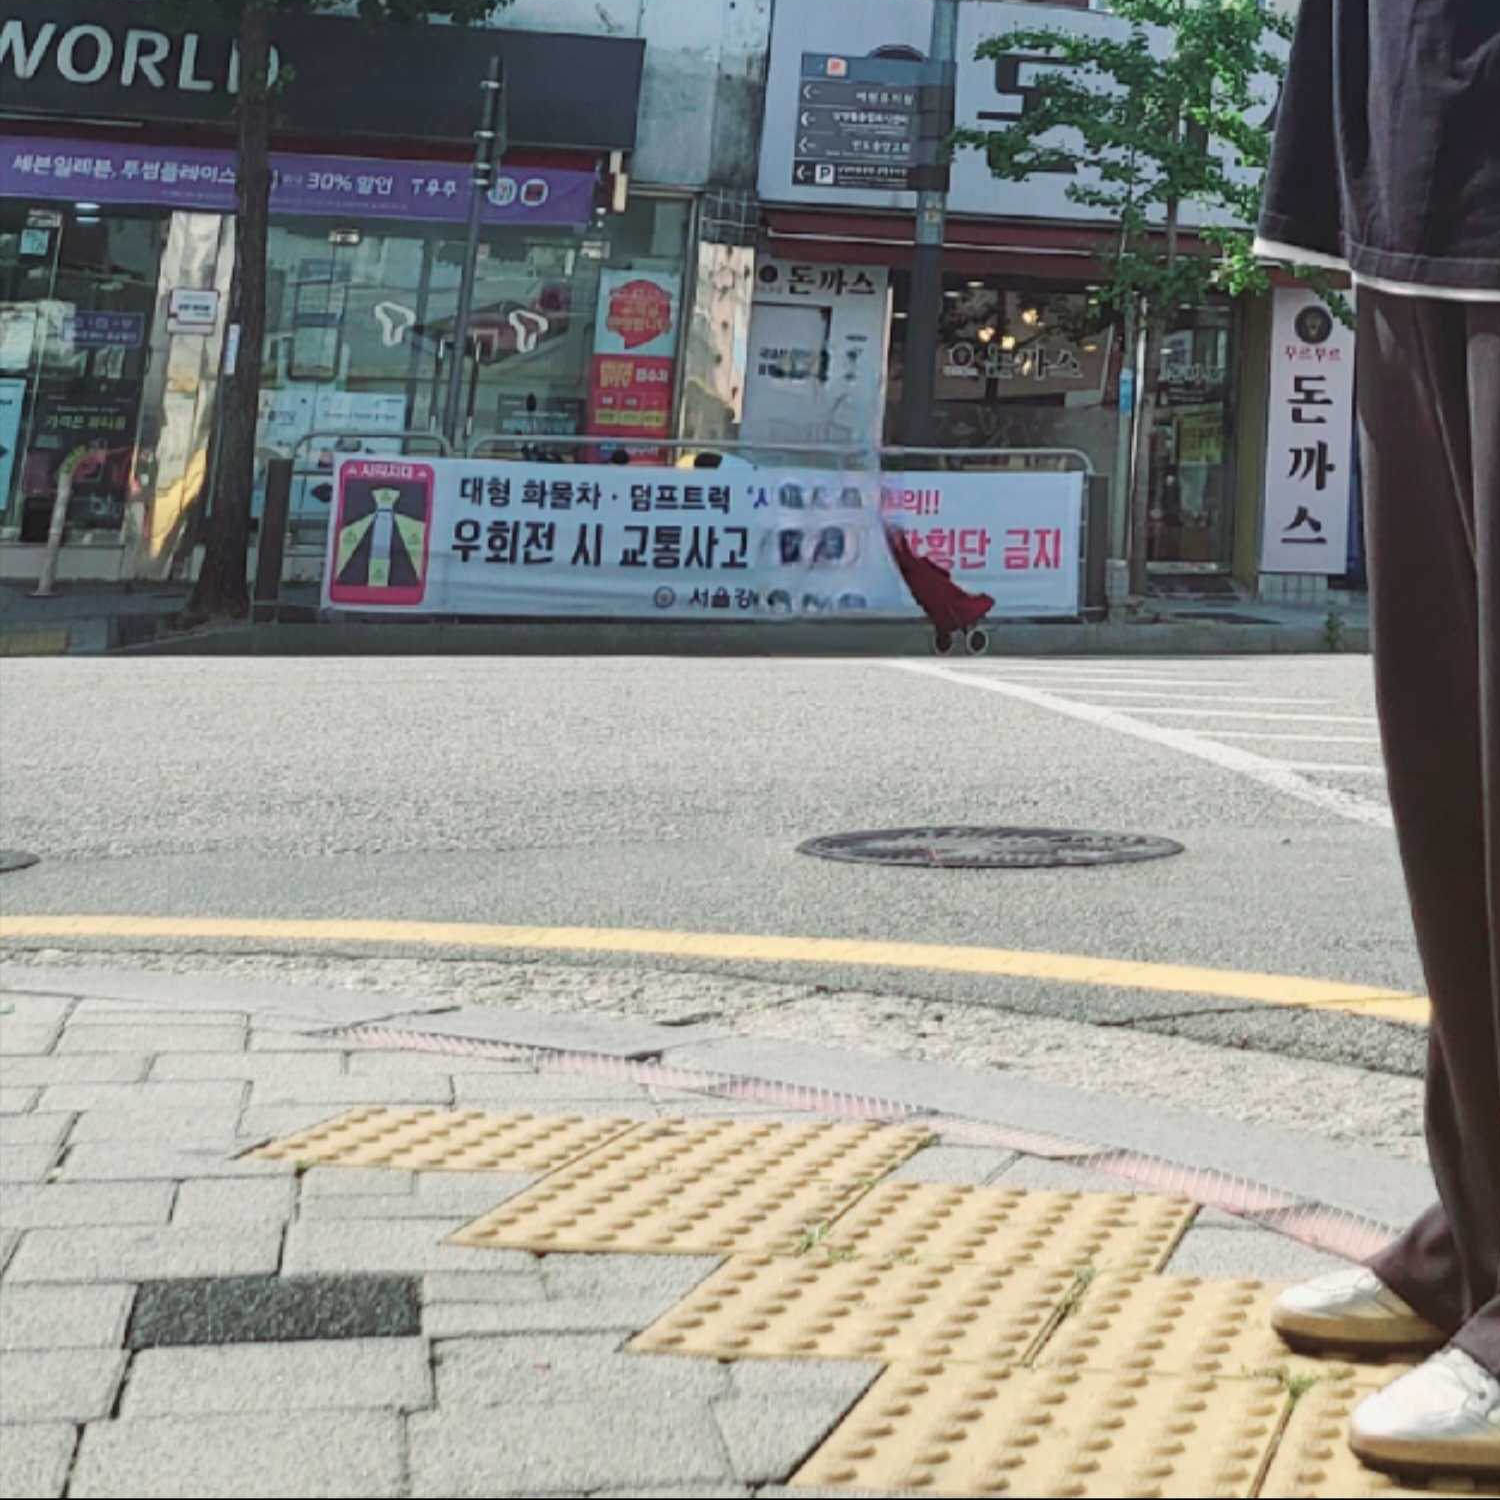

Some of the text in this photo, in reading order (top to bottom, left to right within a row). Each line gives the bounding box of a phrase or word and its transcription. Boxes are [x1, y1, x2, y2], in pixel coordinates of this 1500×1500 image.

[306, 171, 353, 192] 30%
[787, 265, 877, 297] 돈까스
[1280, 374, 1336, 544] 돈까스
[459, 476, 511, 508] 대형
[521, 479, 601, 510] 화물차
[629, 484, 731, 514] 덤프트럭
[451, 519, 556, 565] 우회전
[570, 523, 603, 567] 시
[619, 523, 749, 570] 교통사고
[1003, 528, 1062, 571] 금지
